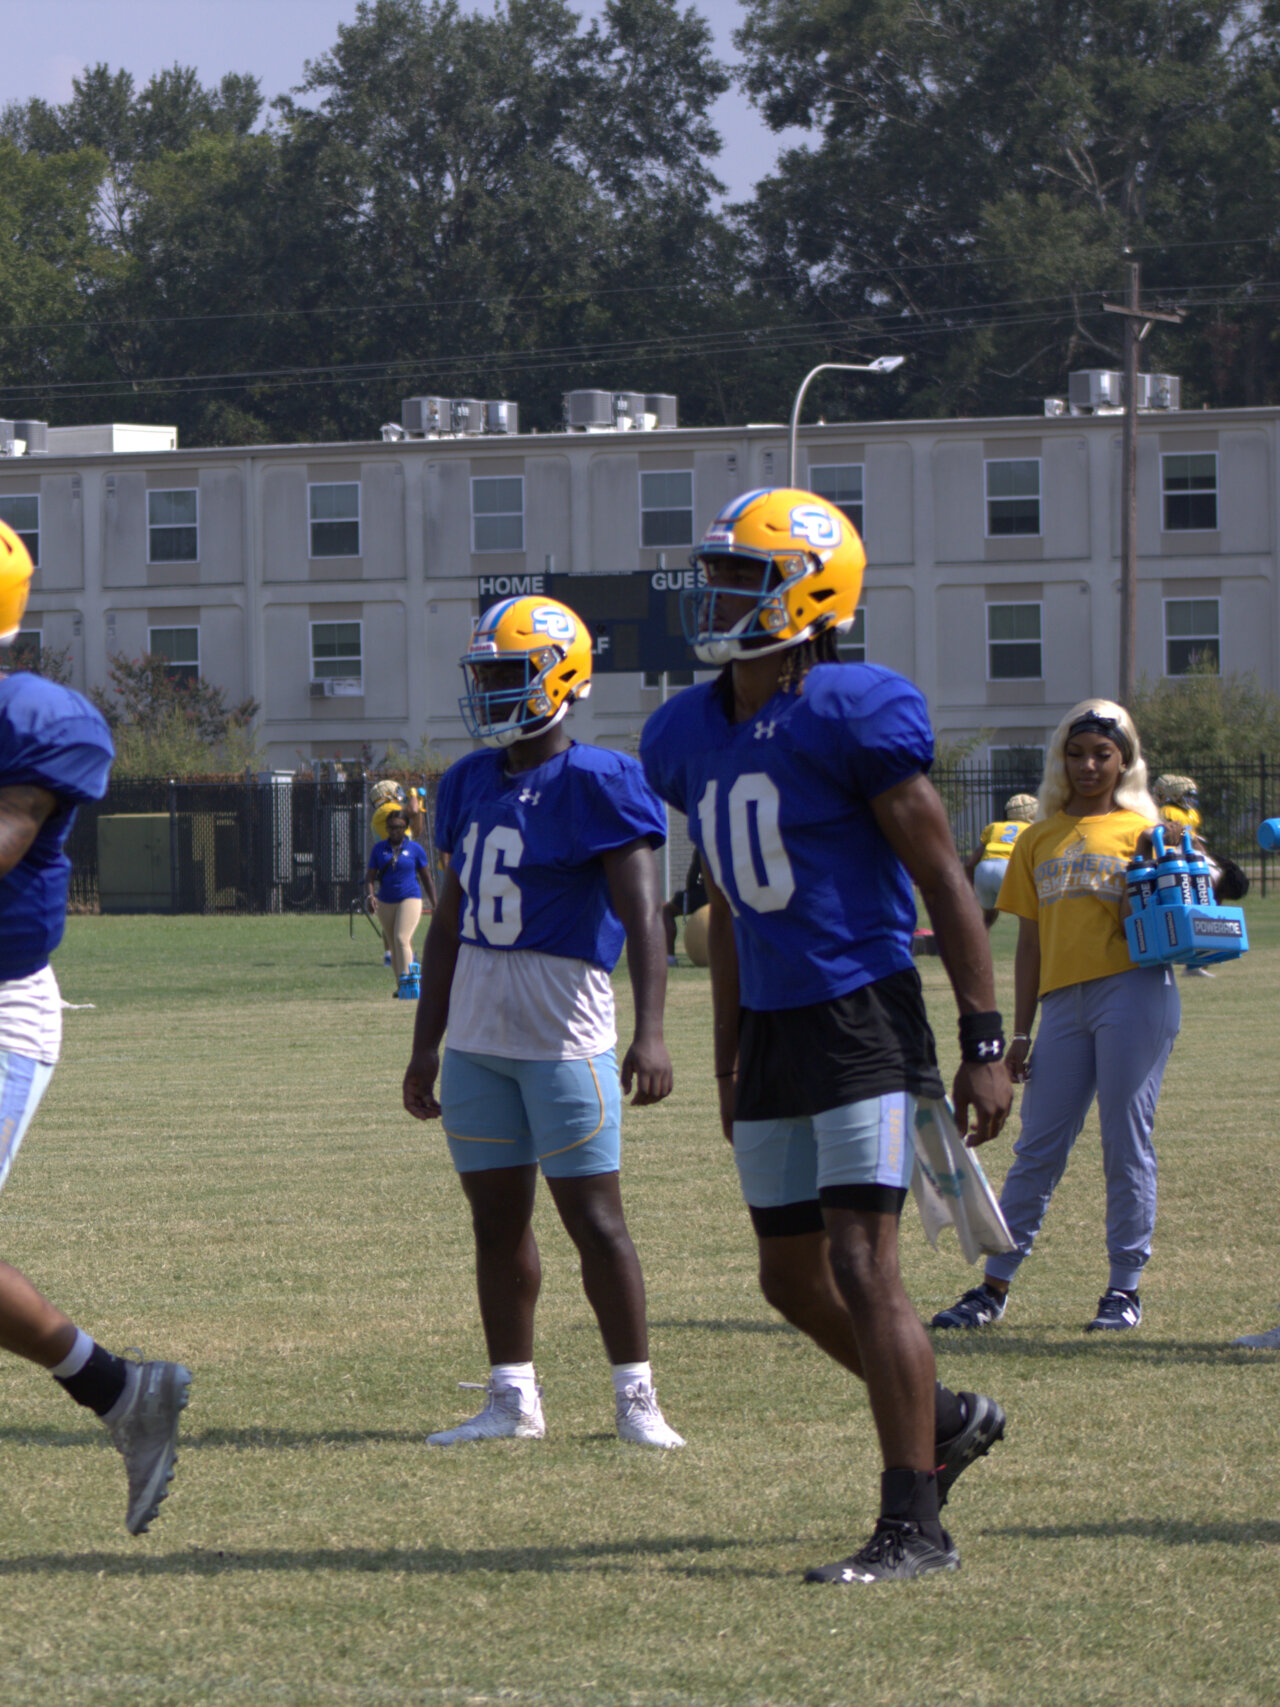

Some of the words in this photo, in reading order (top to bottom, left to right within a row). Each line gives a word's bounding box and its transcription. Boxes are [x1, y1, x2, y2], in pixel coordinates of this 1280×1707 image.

[790, 504, 843, 548] SU
[479, 576, 544, 595] HOME
[531, 605, 576, 641] SU
[697, 772, 796, 917] 10
[1001, 825, 1018, 843] 2
[460, 822, 524, 946] 16
[1194, 920, 1241, 935] POWERADE
